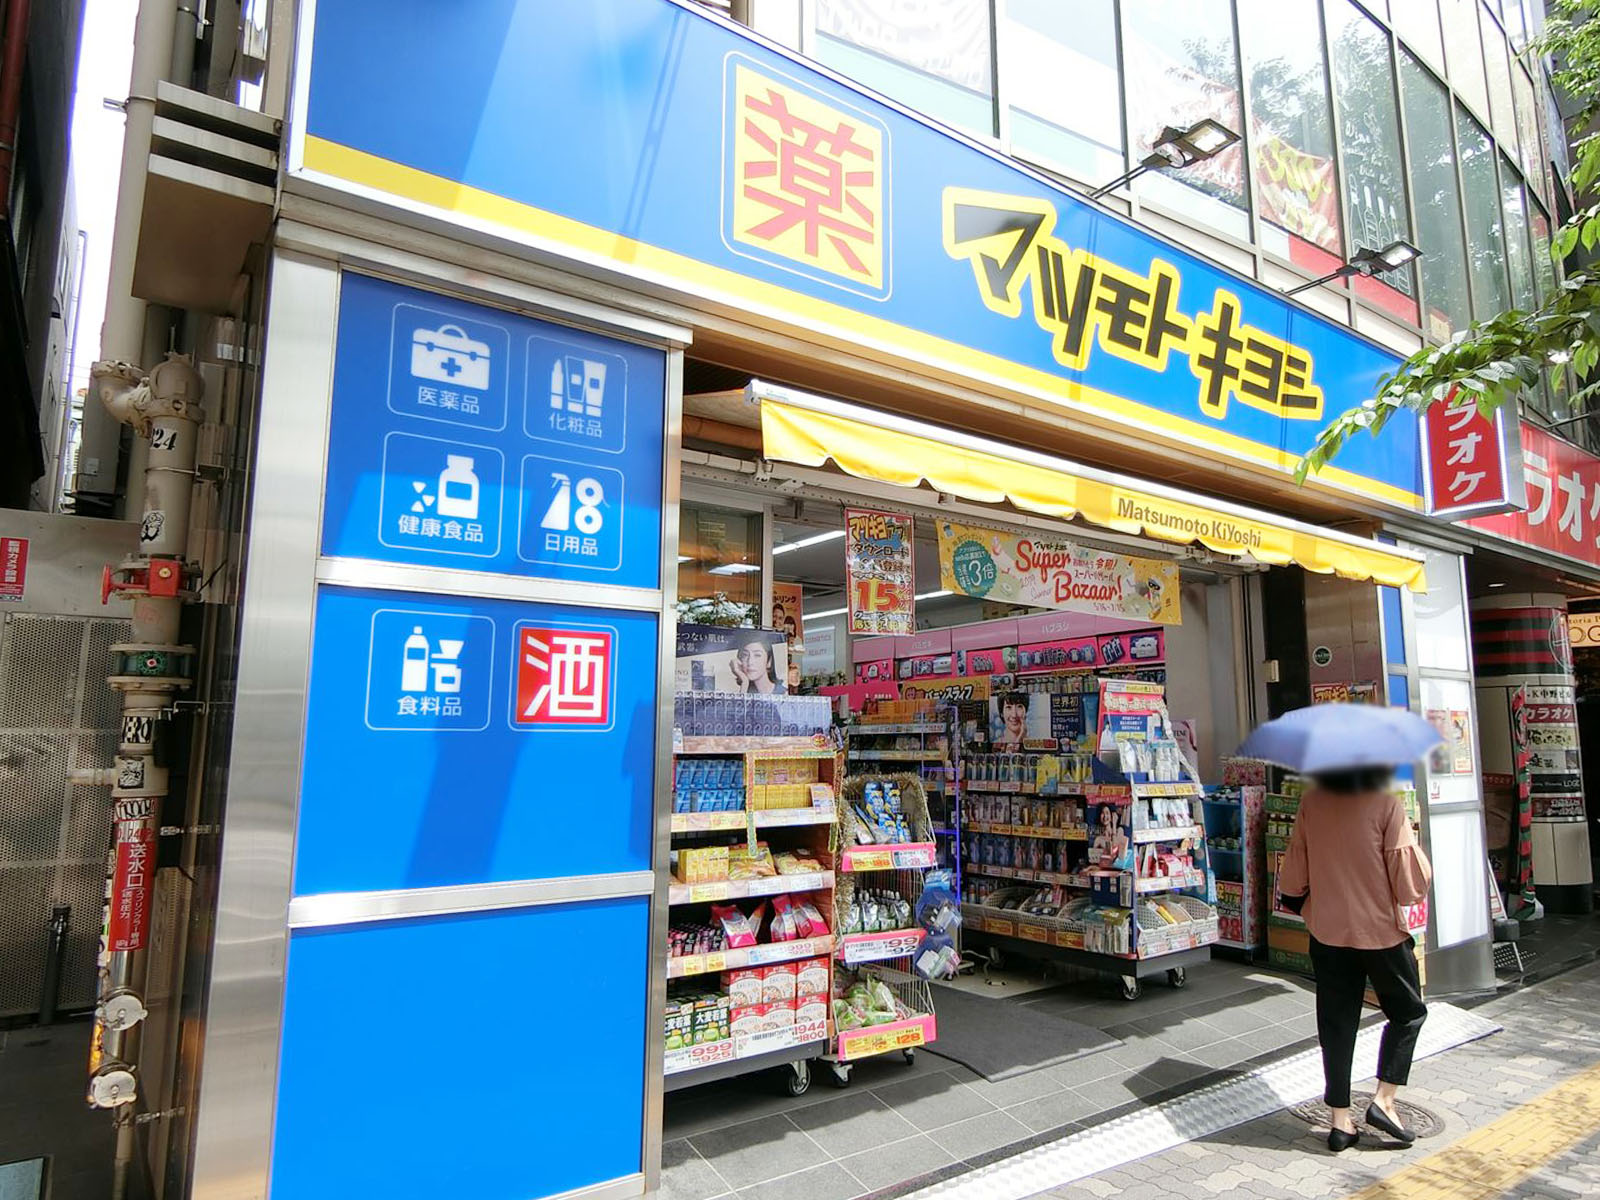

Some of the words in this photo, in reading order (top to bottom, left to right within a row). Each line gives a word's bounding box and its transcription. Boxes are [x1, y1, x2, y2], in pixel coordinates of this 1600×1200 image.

[744, 89, 875, 277] 薬
[954, 202, 1319, 408] マツモトキヨシ
[417, 385, 481, 415] 医薬品
[151, 428, 177, 450] 24
[548, 411, 603, 439] 化粧品
[1443, 396, 1487, 502] ラオケ
[398, 513, 485, 544] 健康食品
[1117, 497, 1209, 537] Matsumoto
[1211, 519, 1262, 549] KiYoshi
[544, 532, 599, 557] 日用品
[1015, 540, 1072, 585] Super
[1053, 570, 1123, 604] Bazaar!
[522, 635, 605, 718] 酒
[397, 695, 462, 717] 食料品
[128, 843, 147, 888] 送水口
[692, 1042, 733, 1057] 999
